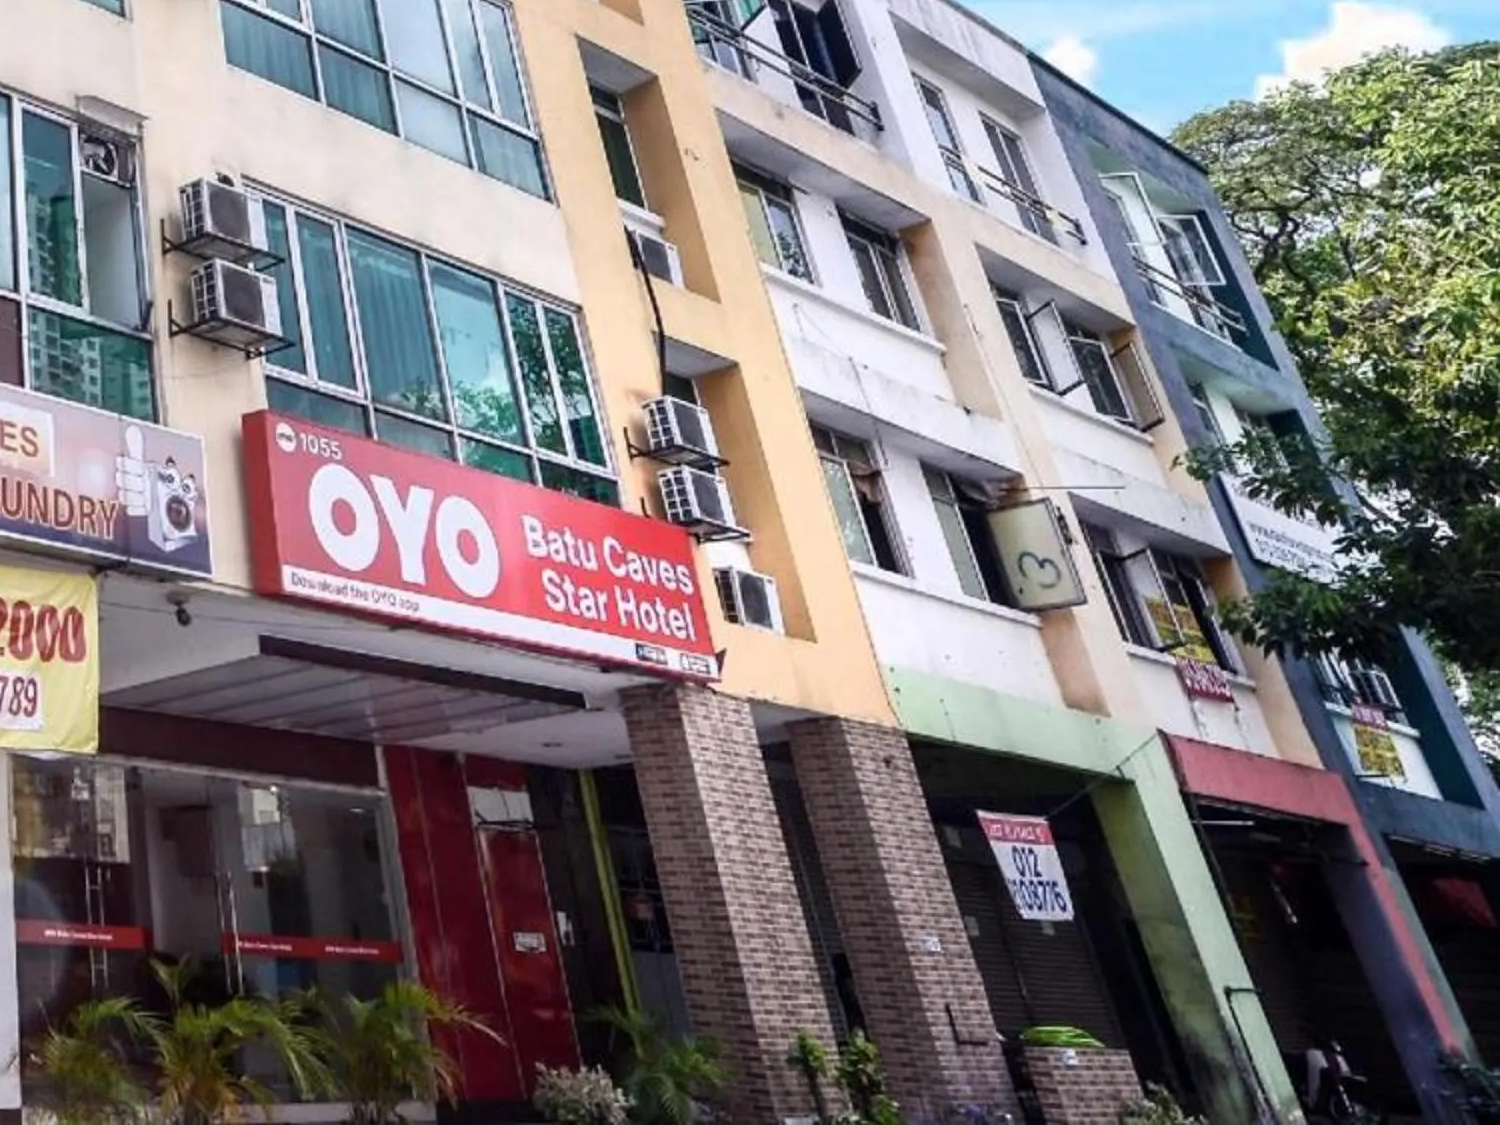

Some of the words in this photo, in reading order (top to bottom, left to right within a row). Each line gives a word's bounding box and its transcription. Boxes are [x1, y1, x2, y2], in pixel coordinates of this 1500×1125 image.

[300, 433, 342, 460] 1055
[309, 464, 500, 598] OYO
[522, 515, 597, 569] Batu
[604, 536, 694, 593] Caves
[541, 569, 609, 620] Star
[617, 588, 696, 642] Hotel
[1012, 845, 1043, 878] 012
